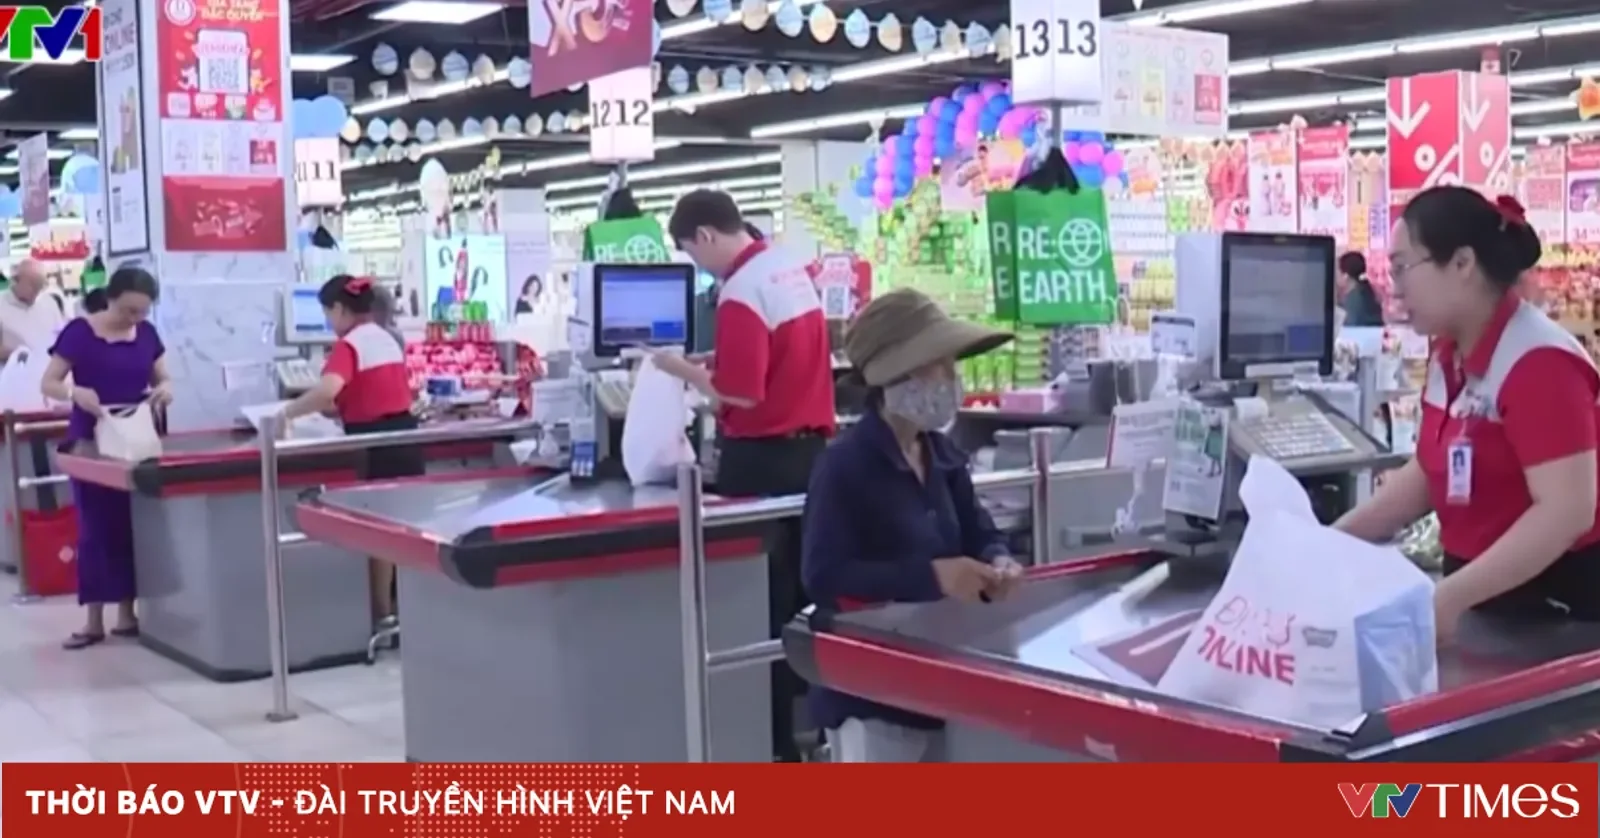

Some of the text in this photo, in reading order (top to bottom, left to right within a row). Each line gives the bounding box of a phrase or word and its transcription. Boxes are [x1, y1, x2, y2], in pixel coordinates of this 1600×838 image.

[1015, 19, 1050, 60] 13
[1057, 18, 1097, 57] 13
[592, 100, 611, 129] 12
[614, 99, 650, 126] 12
[312, 160, 337, 181] 11
[1019, 269, 1107, 305] EARTH
